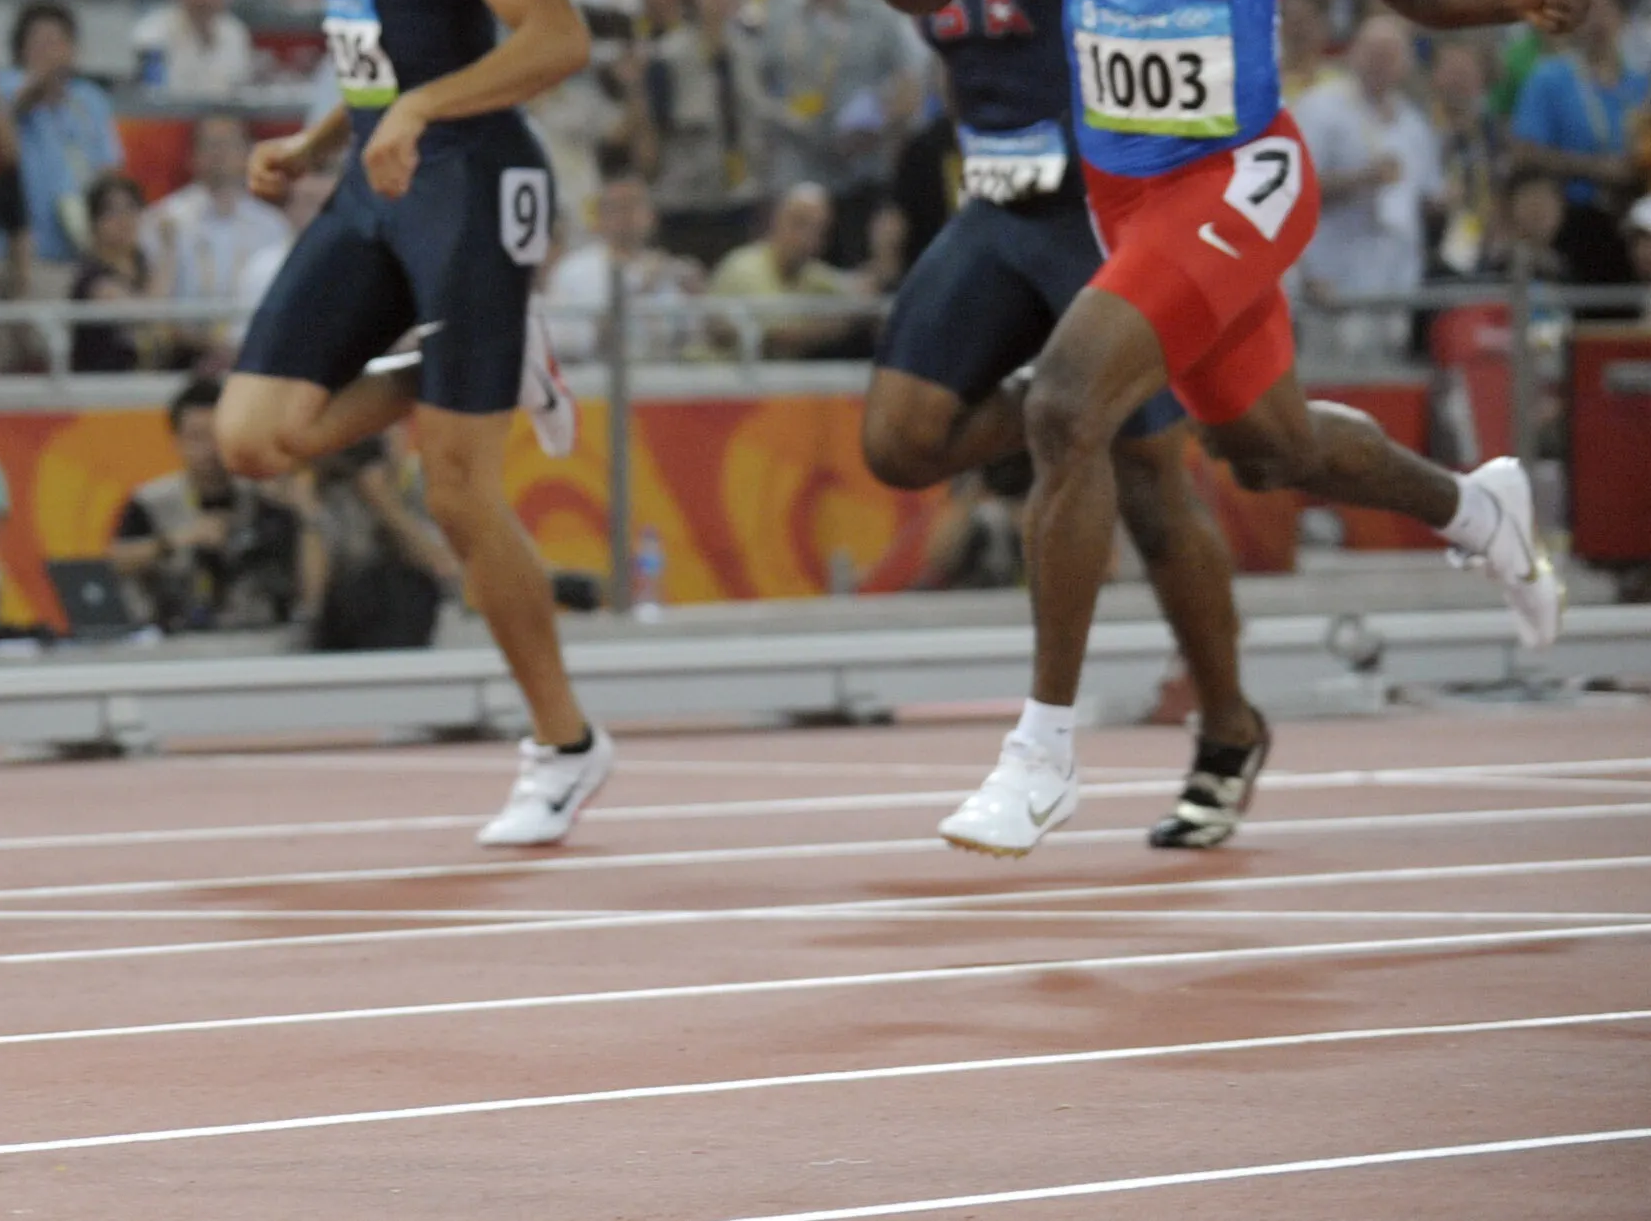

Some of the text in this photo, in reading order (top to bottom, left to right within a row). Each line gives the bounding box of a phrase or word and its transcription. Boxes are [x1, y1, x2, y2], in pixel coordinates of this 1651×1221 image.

[1091, 43, 1208, 111] 1003
[1246, 149, 1290, 205] 7
[512, 183, 538, 249] 9
